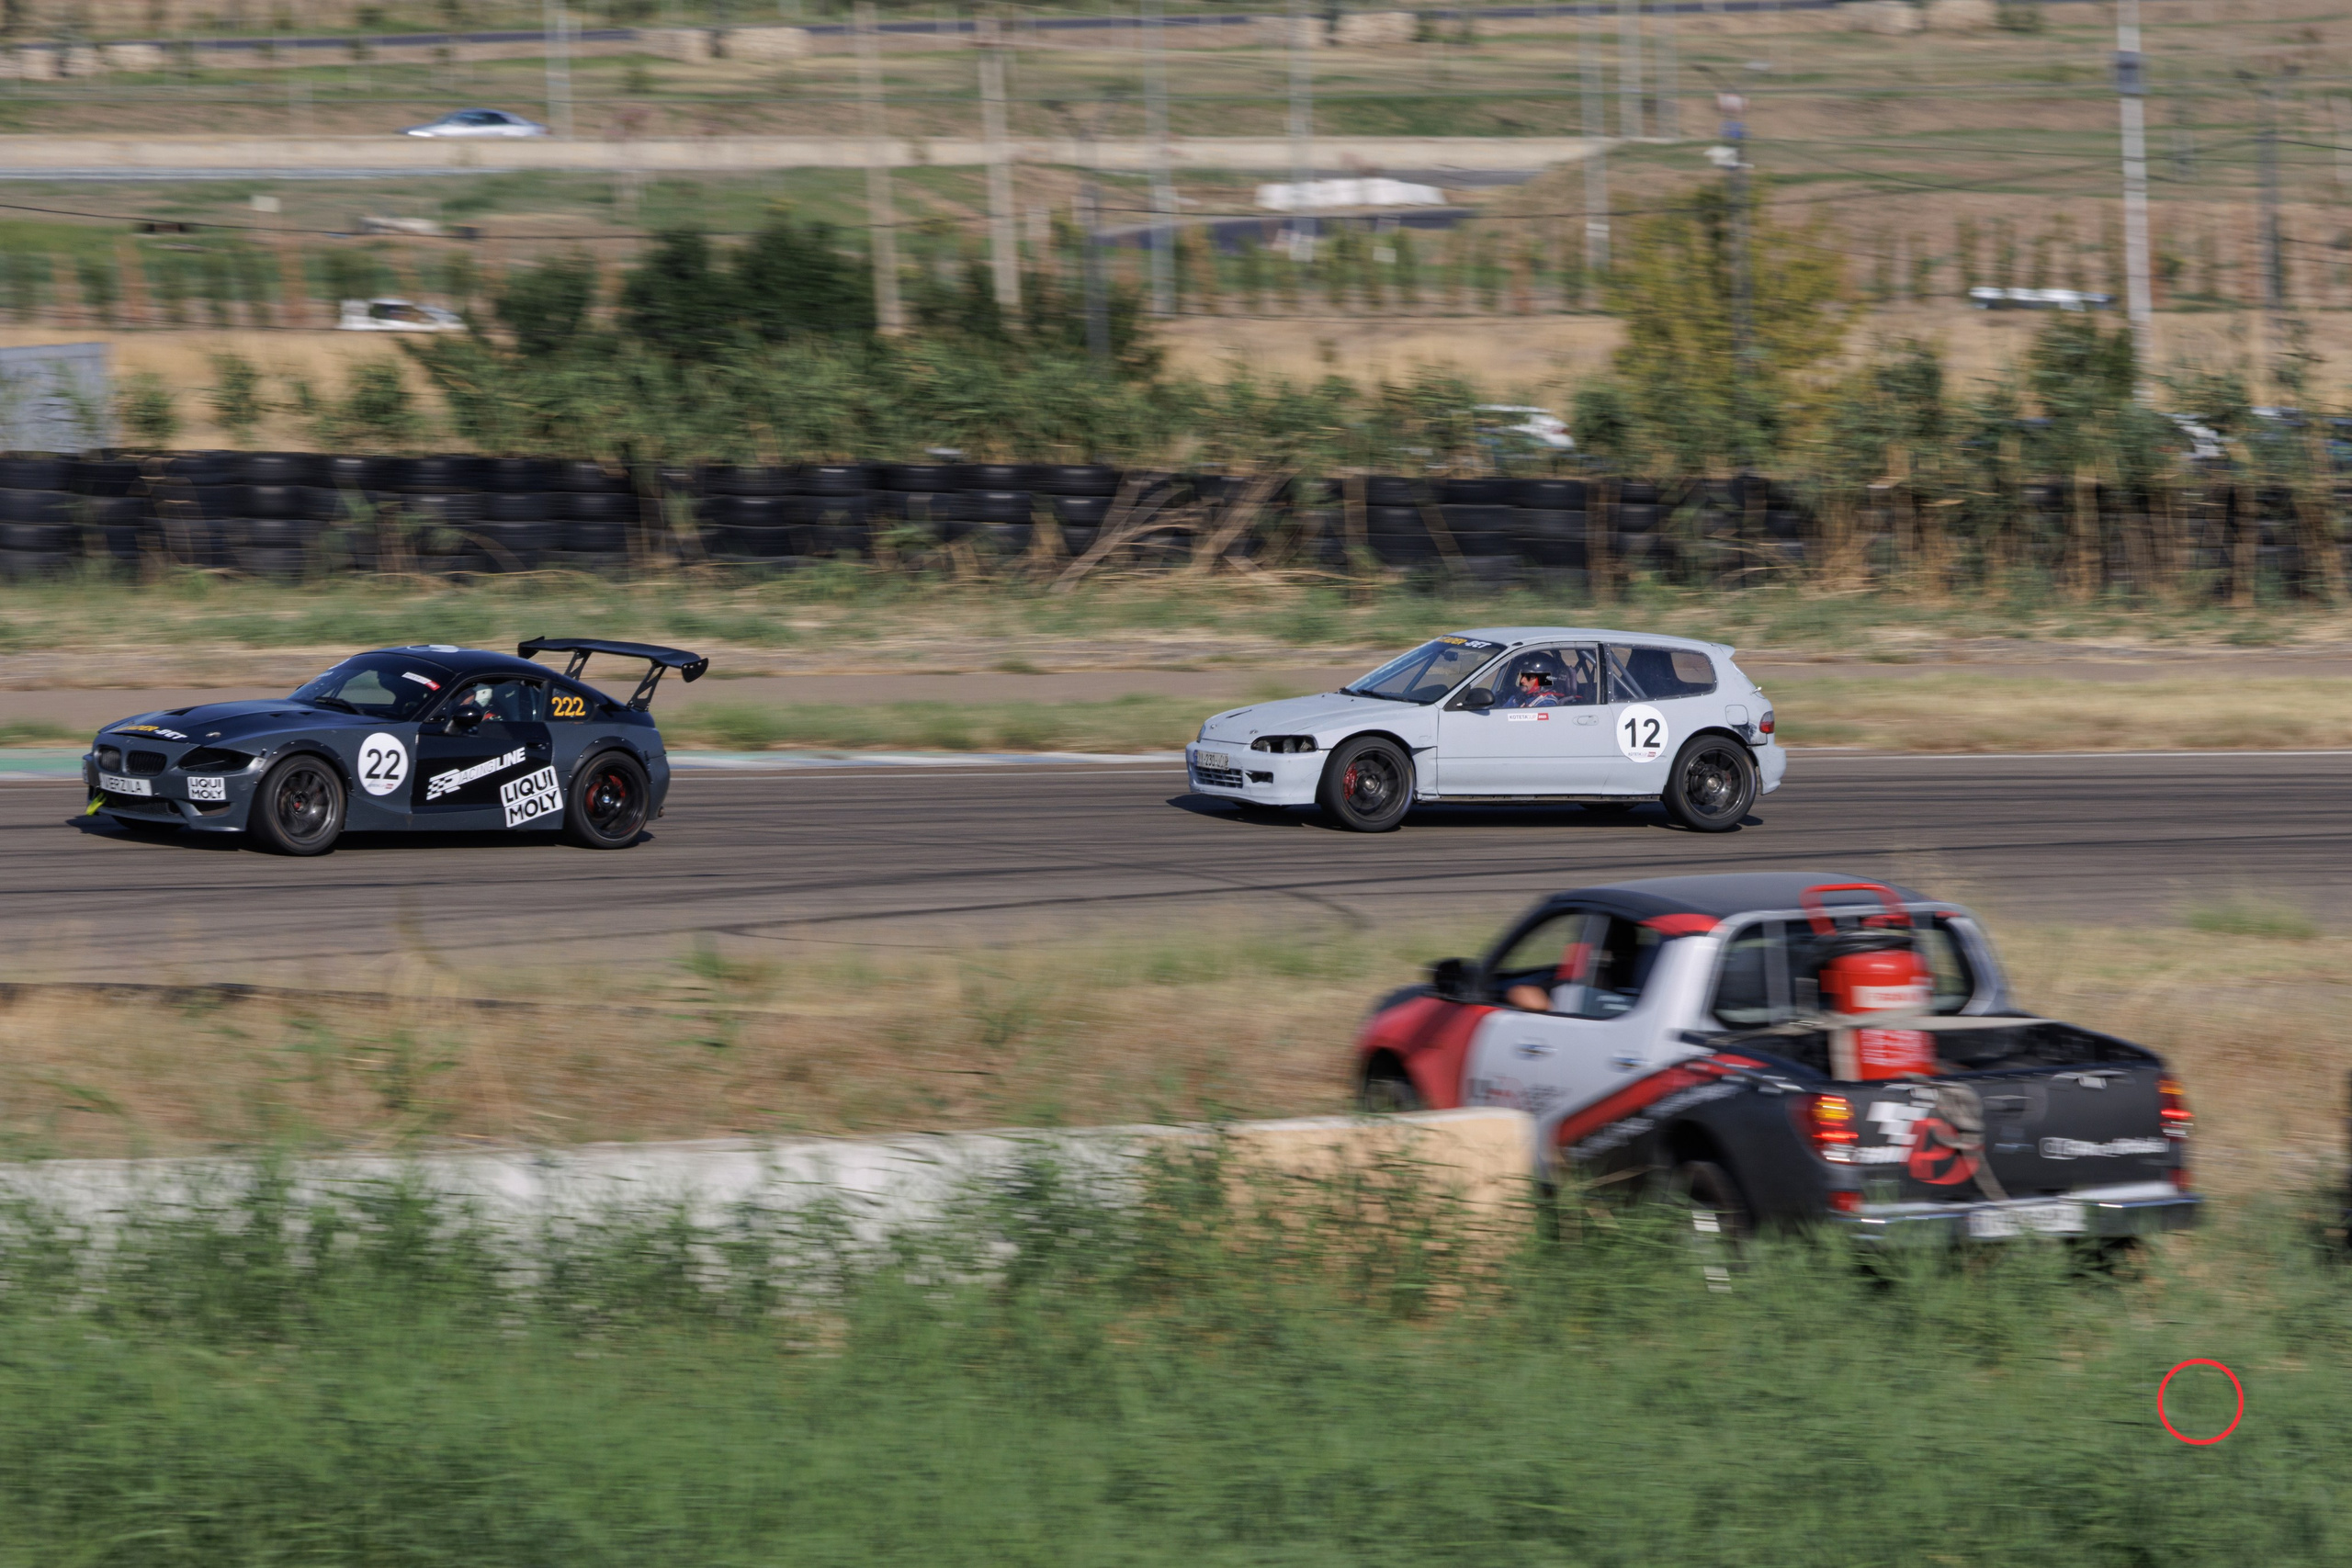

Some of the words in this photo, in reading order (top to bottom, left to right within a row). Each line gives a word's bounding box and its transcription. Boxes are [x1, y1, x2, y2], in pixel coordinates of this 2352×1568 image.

[551, 696, 586, 716] 222
[1624, 717, 1661, 748] 12
[365, 748, 401, 780] 22
[190, 778, 221, 788] LIQUI
[191, 790, 222, 799] MOLY
[504, 769, 554, 804] LIQUI
[510, 790, 558, 825] MOLY
